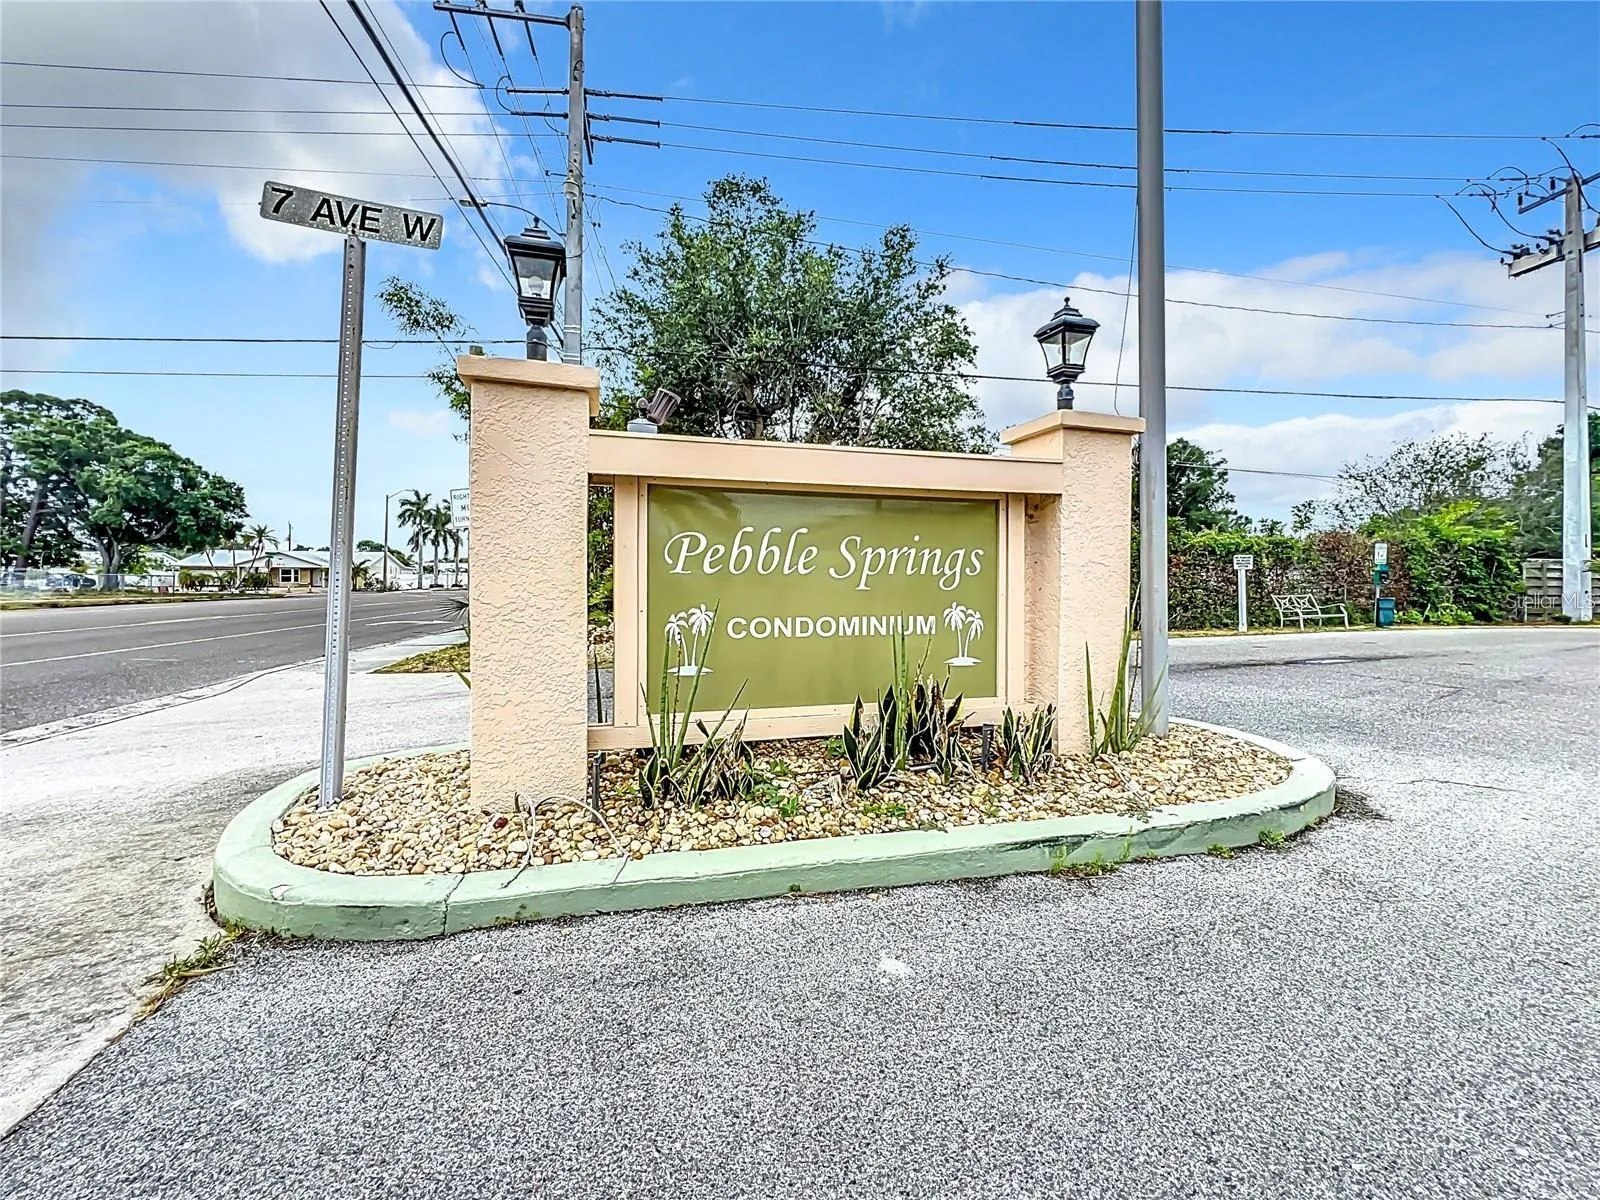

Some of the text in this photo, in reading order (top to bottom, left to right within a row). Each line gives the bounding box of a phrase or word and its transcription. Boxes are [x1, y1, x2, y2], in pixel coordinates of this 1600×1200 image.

[271, 187, 437, 242] 7 AVE W
[663, 526, 985, 591] Pebble Springs
[726, 615, 937, 639] CONDOMINIUM
